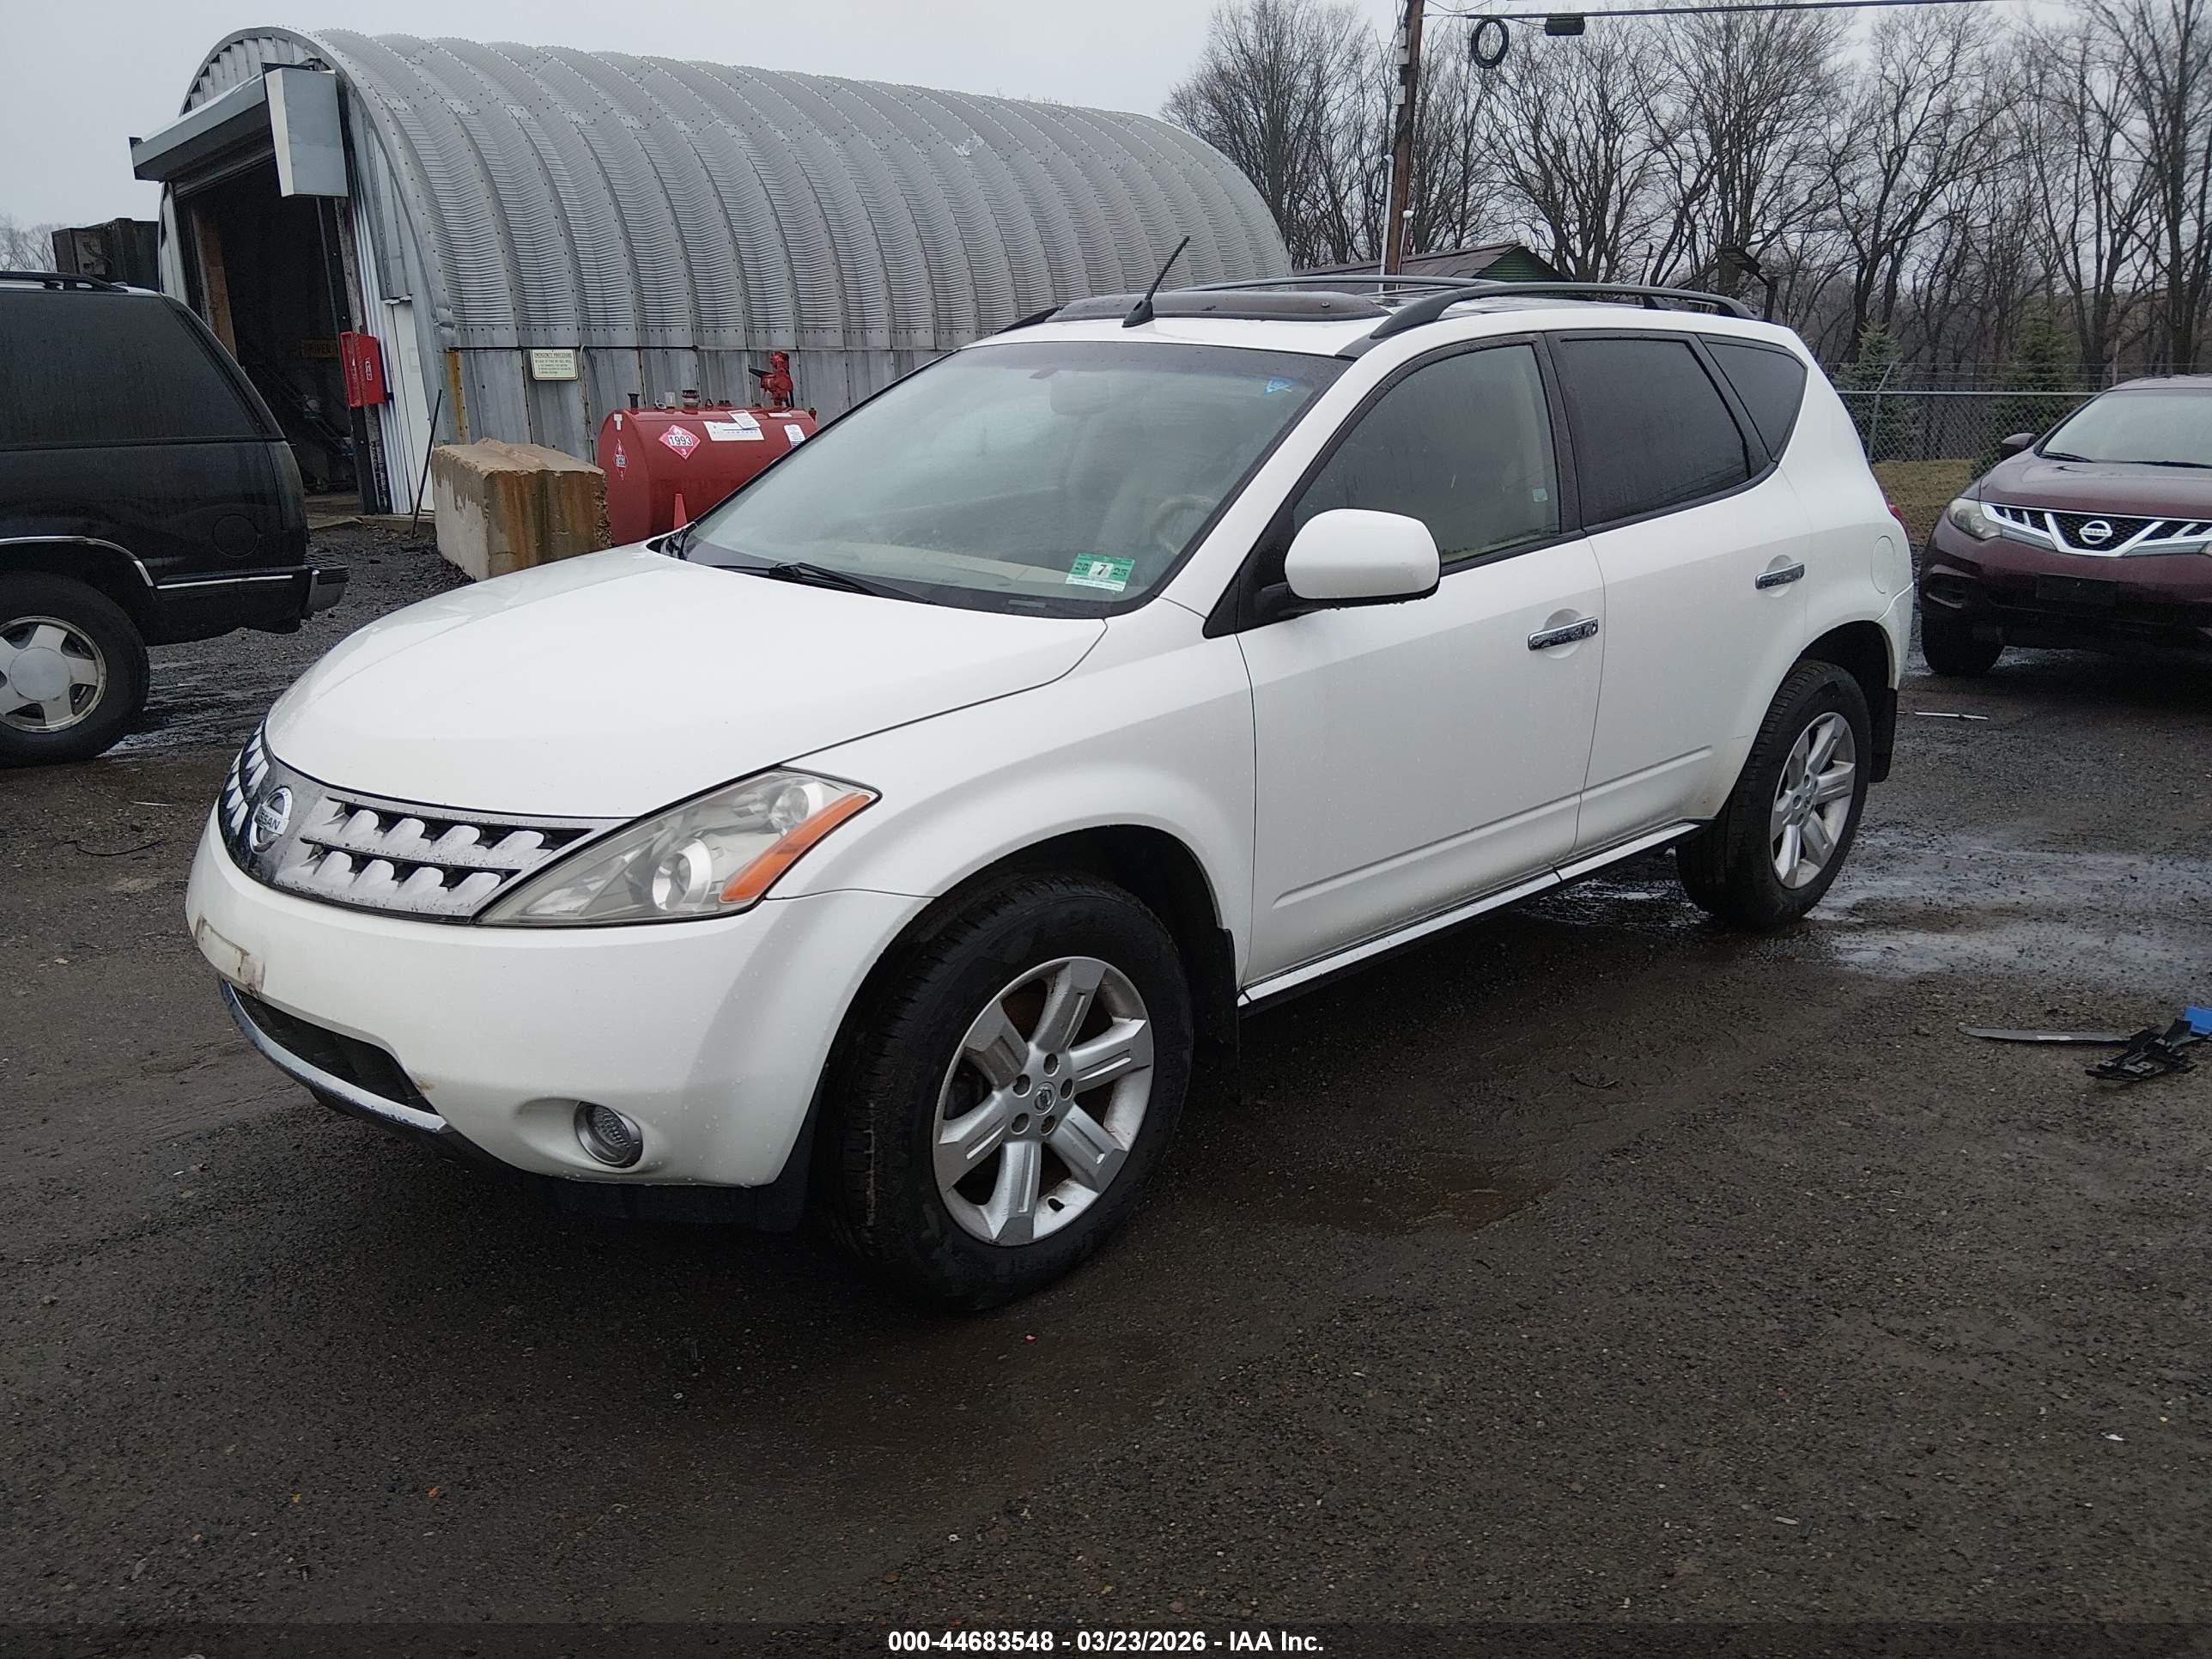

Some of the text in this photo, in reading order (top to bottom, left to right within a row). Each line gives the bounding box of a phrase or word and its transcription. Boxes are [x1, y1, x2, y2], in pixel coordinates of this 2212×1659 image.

[670, 435, 692, 446] 1993
[1098, 564, 1108, 575] 7
[1113, 568, 1128, 576] 25
